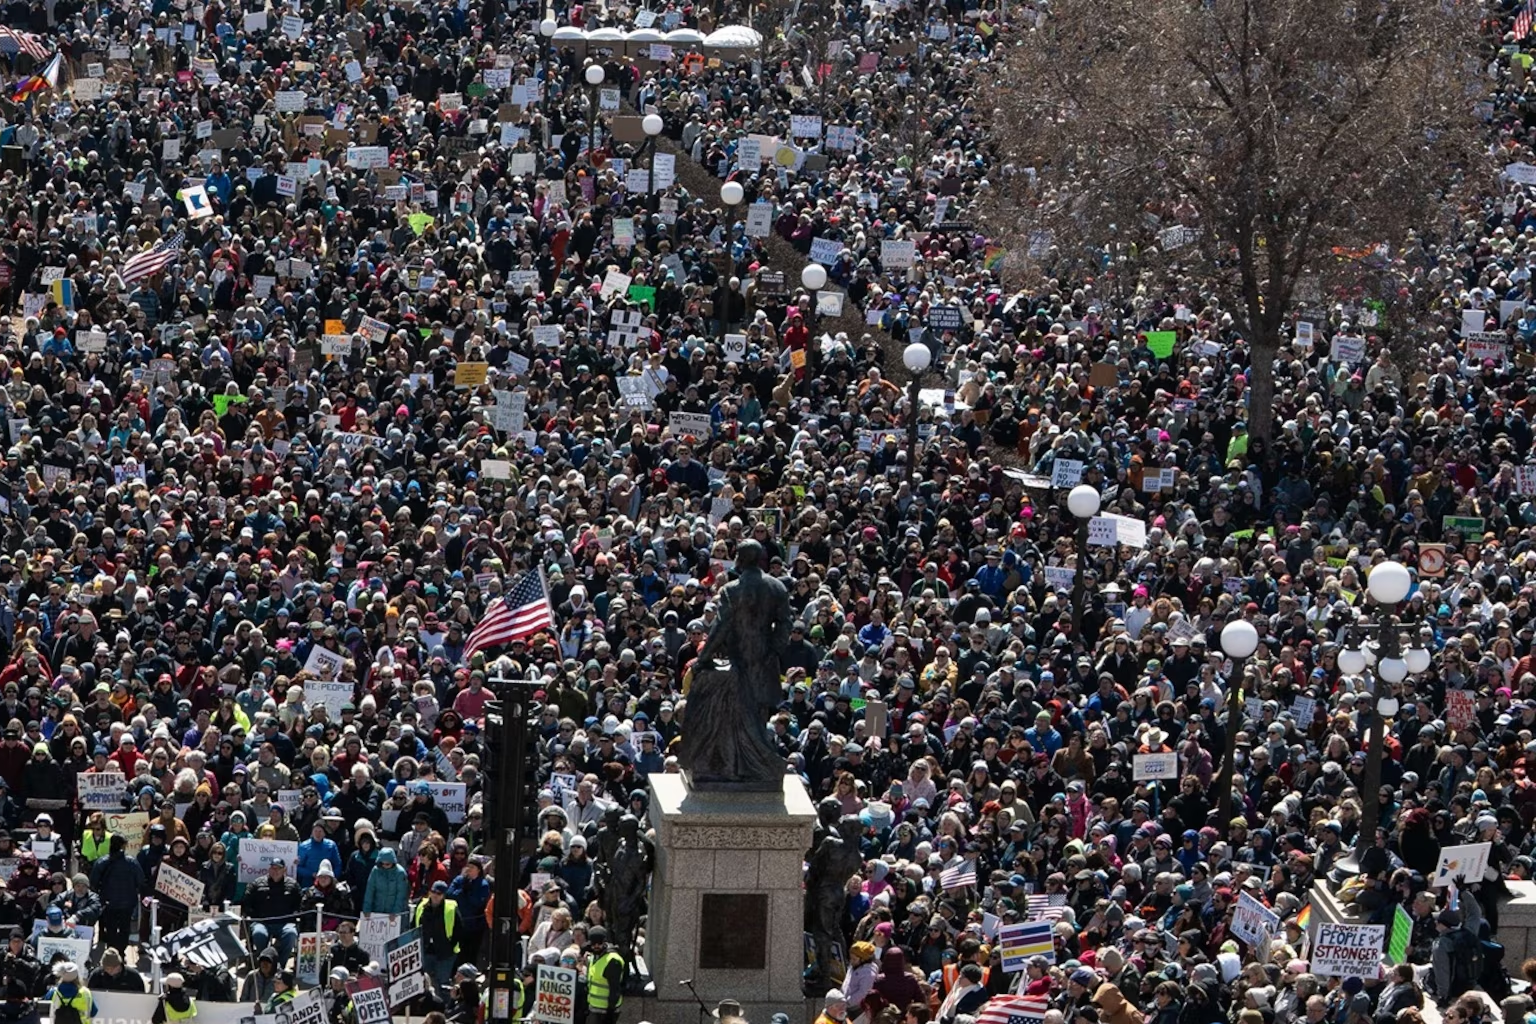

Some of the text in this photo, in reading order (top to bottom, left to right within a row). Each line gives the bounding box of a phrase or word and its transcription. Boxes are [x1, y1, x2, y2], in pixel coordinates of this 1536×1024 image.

[670, 413, 710, 423] WHO WILL
[679, 427, 704, 437] NEXT?
[321, 683, 353, 692] PEOPLE
[88, 774, 116, 787] THIS
[177, 873, 201, 893] PEOPLE
[1320, 929, 1364, 947] PEOPLE
[389, 942, 419, 961] HANDS
[1314, 945, 1378, 960] STRONGER
[390, 954, 421, 979] OFF!
[540, 970, 573, 983] NO
[539, 980, 572, 995] KINGS
[354, 989, 382, 1004] HANDS
[538, 993, 571, 1006] NO
[357, 999, 387, 1020] OFF!
[537, 1003, 571, 1019] FASCISTS
